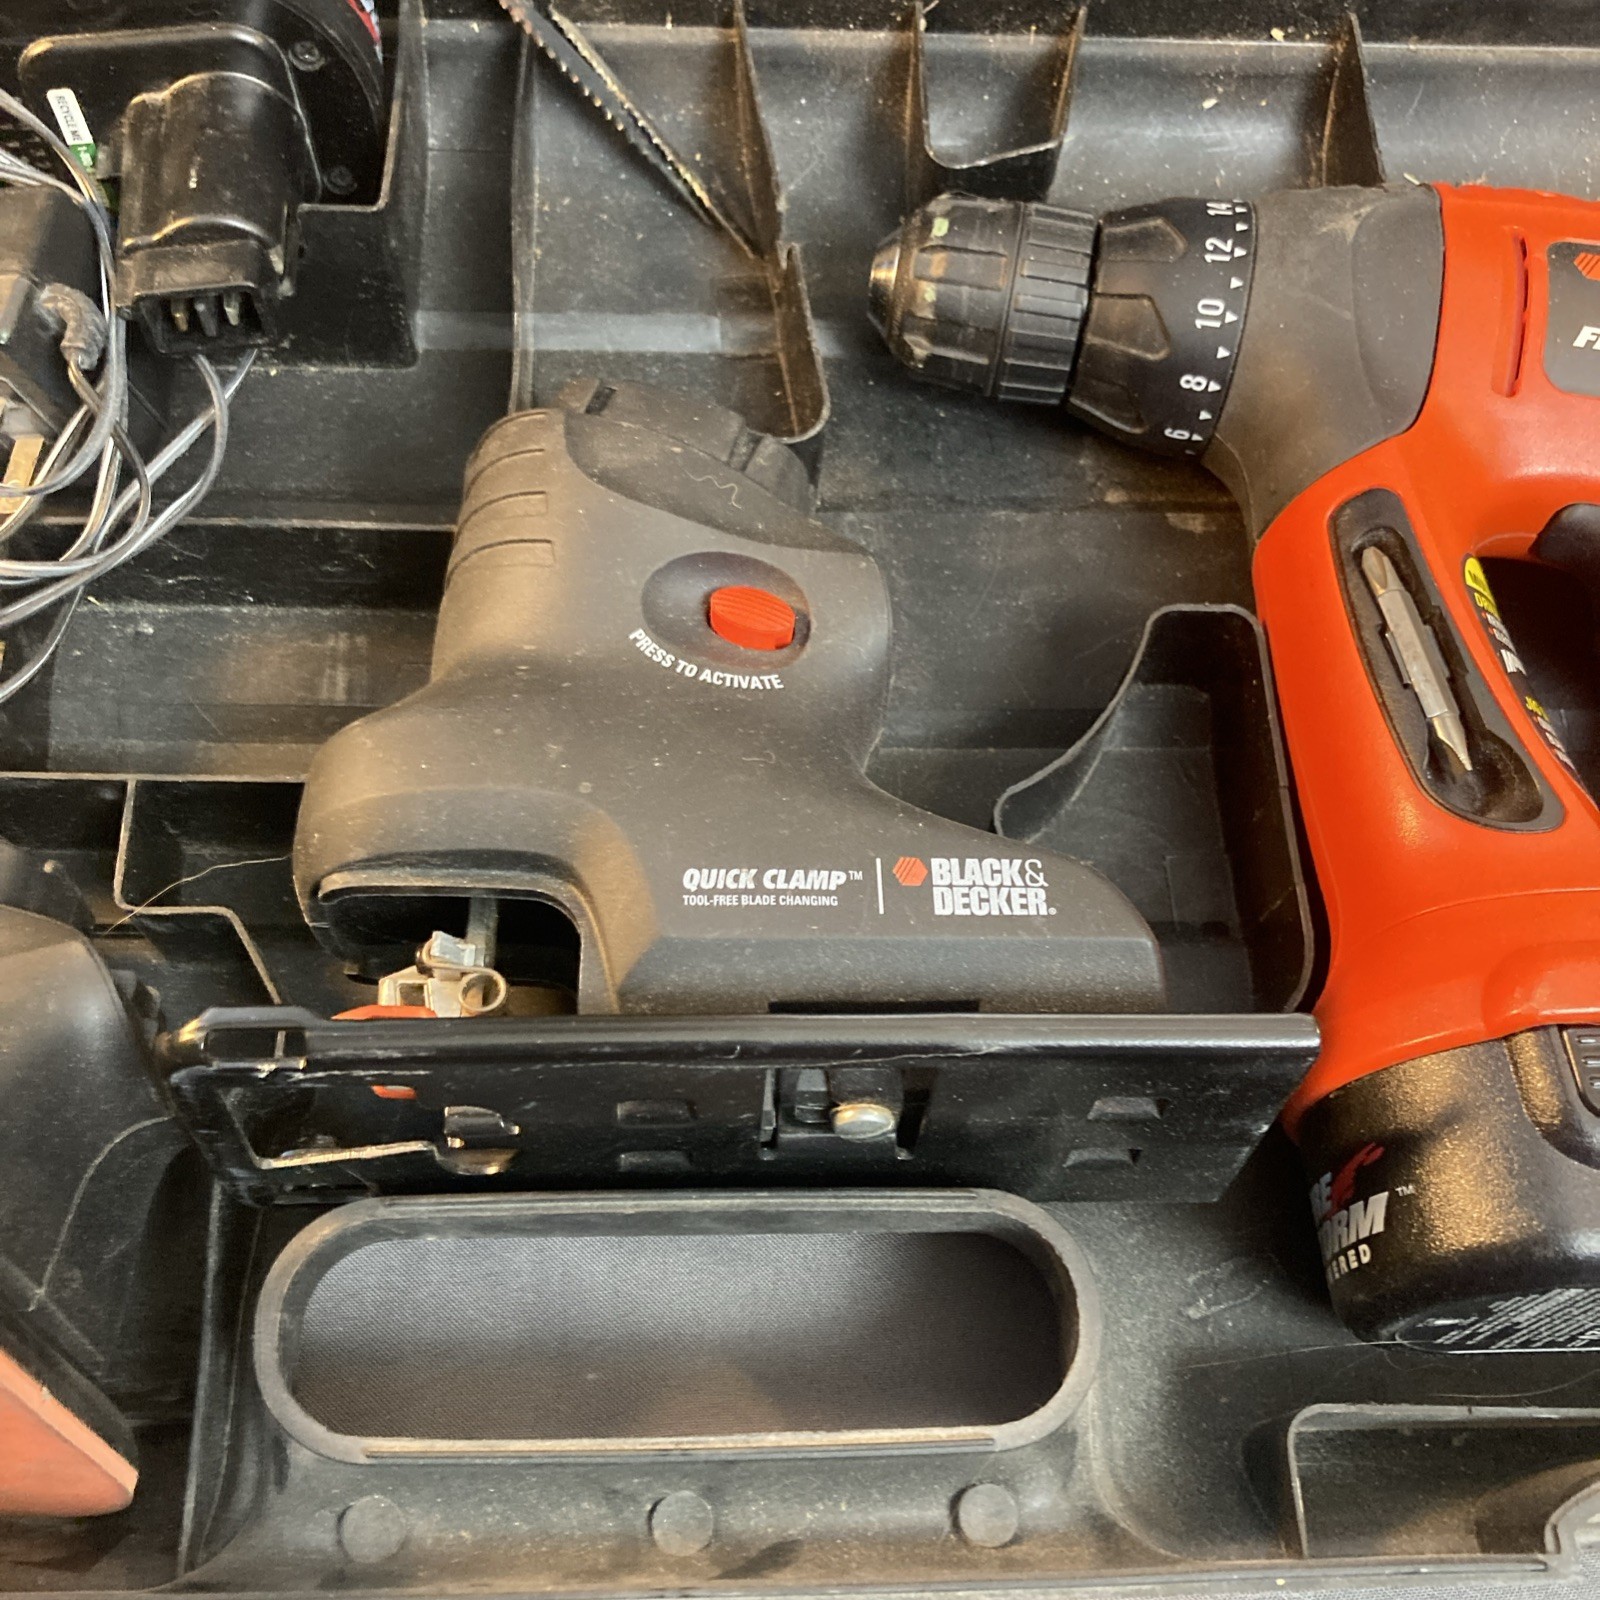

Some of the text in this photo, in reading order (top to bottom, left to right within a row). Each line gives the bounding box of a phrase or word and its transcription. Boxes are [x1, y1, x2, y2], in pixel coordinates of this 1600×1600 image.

[56, 95, 83, 141] RECYCLE ME
[1206, 202, 1233, 216] 14
[1204, 237, 1233, 263] 12
[1195, 298, 1225, 329] 10
[1179, 374, 1207, 392] 8
[1164, 427, 1190, 440] 6
[628, 628, 784, 690] PRESS TO ACTIVATE
[683, 868, 758, 892] QUICK
[683, 894, 838, 907] TOOL-FREE BLADE CHANGING
